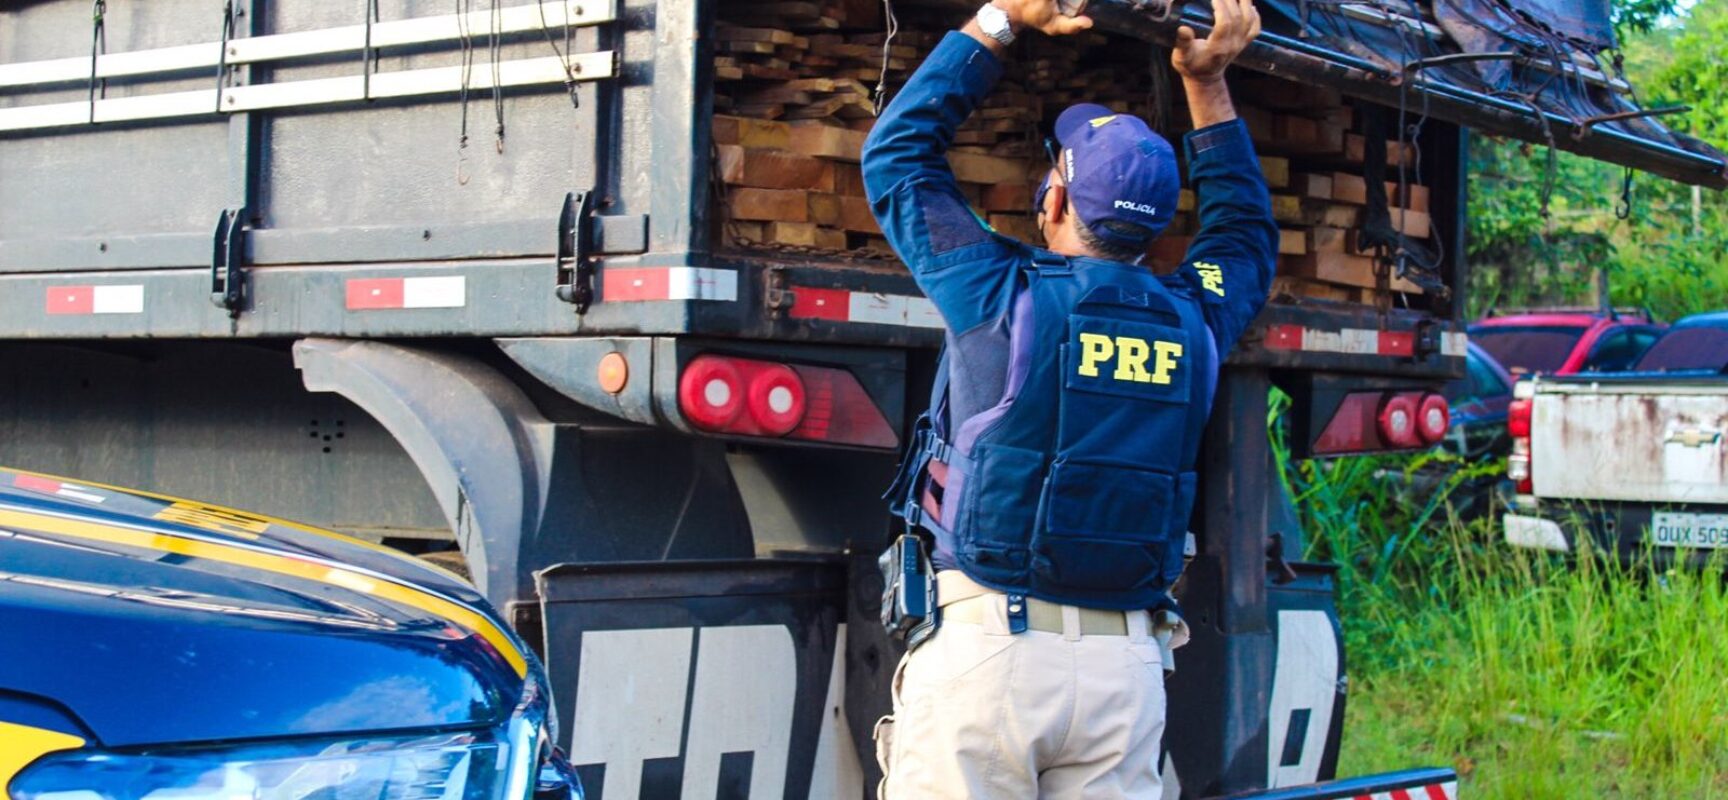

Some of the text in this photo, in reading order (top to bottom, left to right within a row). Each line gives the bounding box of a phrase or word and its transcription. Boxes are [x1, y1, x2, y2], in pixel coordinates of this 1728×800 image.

[1192, 261, 1226, 297] PRF
[1078, 332, 1183, 384] PRF
[1658, 526, 1691, 542] OUX
